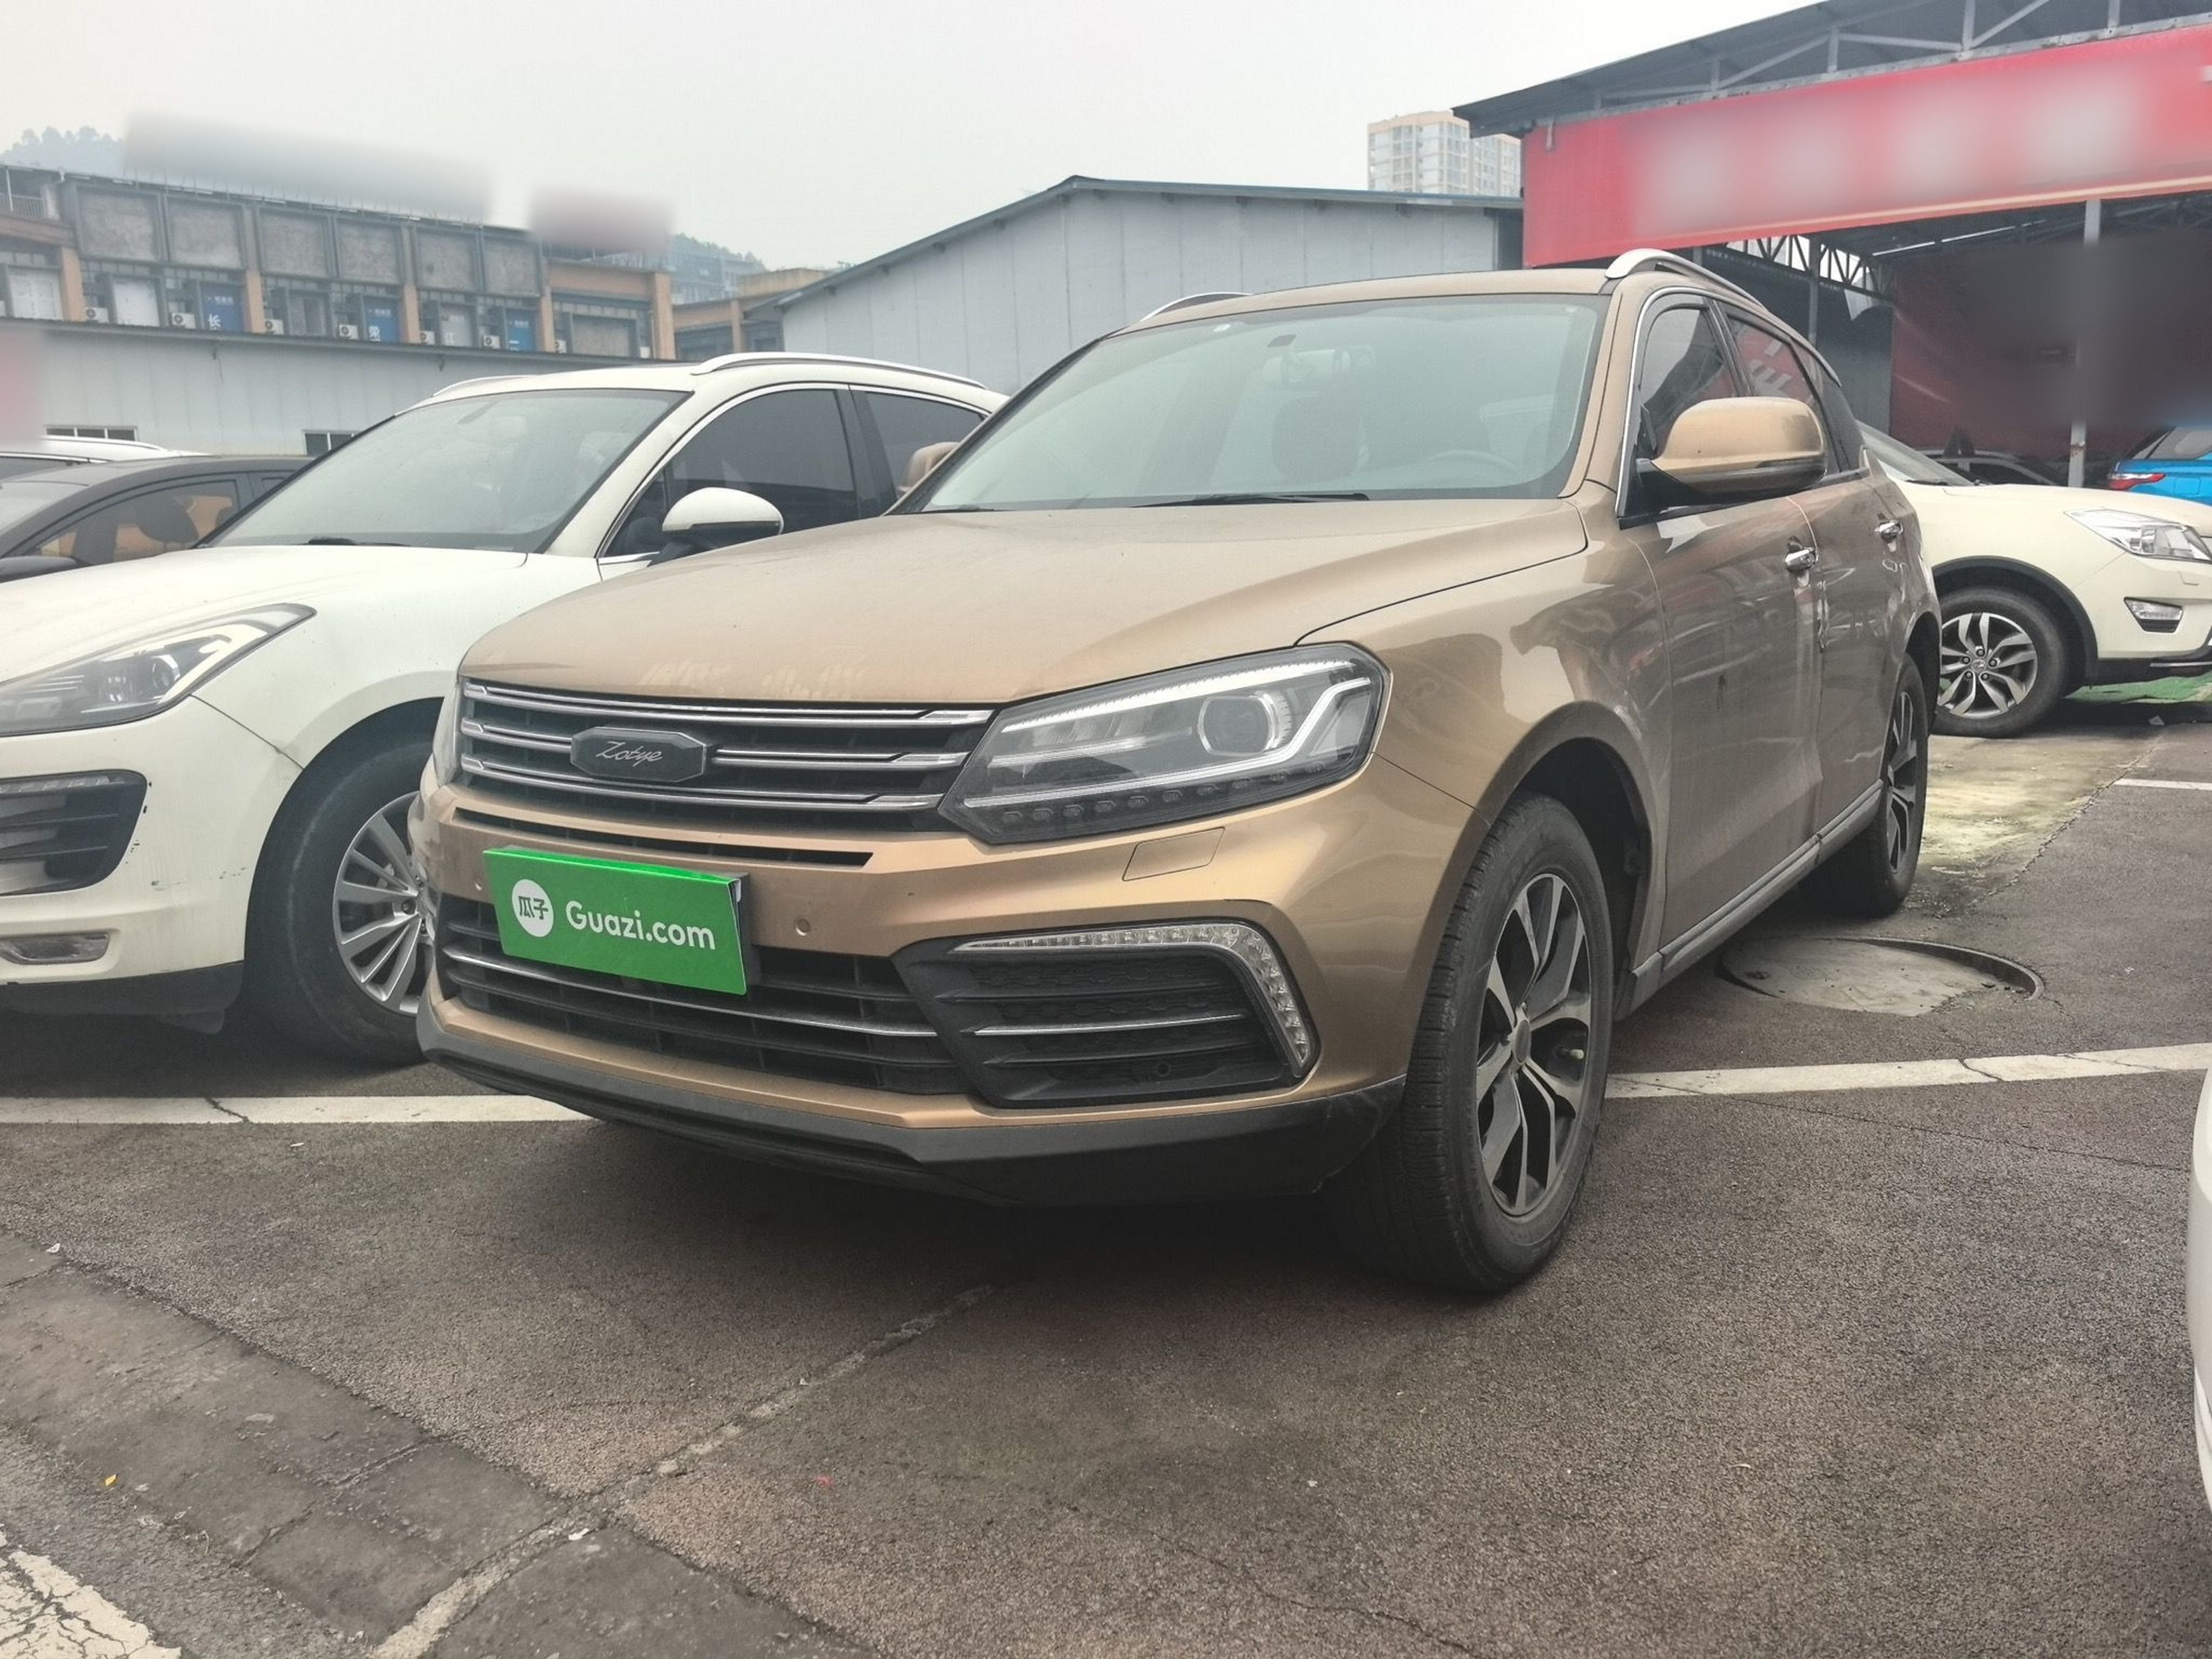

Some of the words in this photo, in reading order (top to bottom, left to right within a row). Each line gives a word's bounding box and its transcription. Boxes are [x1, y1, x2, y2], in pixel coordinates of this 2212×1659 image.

[207, 313, 221, 330] 长
[596, 741, 663, 767] Zotye
[518, 896, 548, 921] 瓜子
[565, 900, 716, 950] Guazi.com
